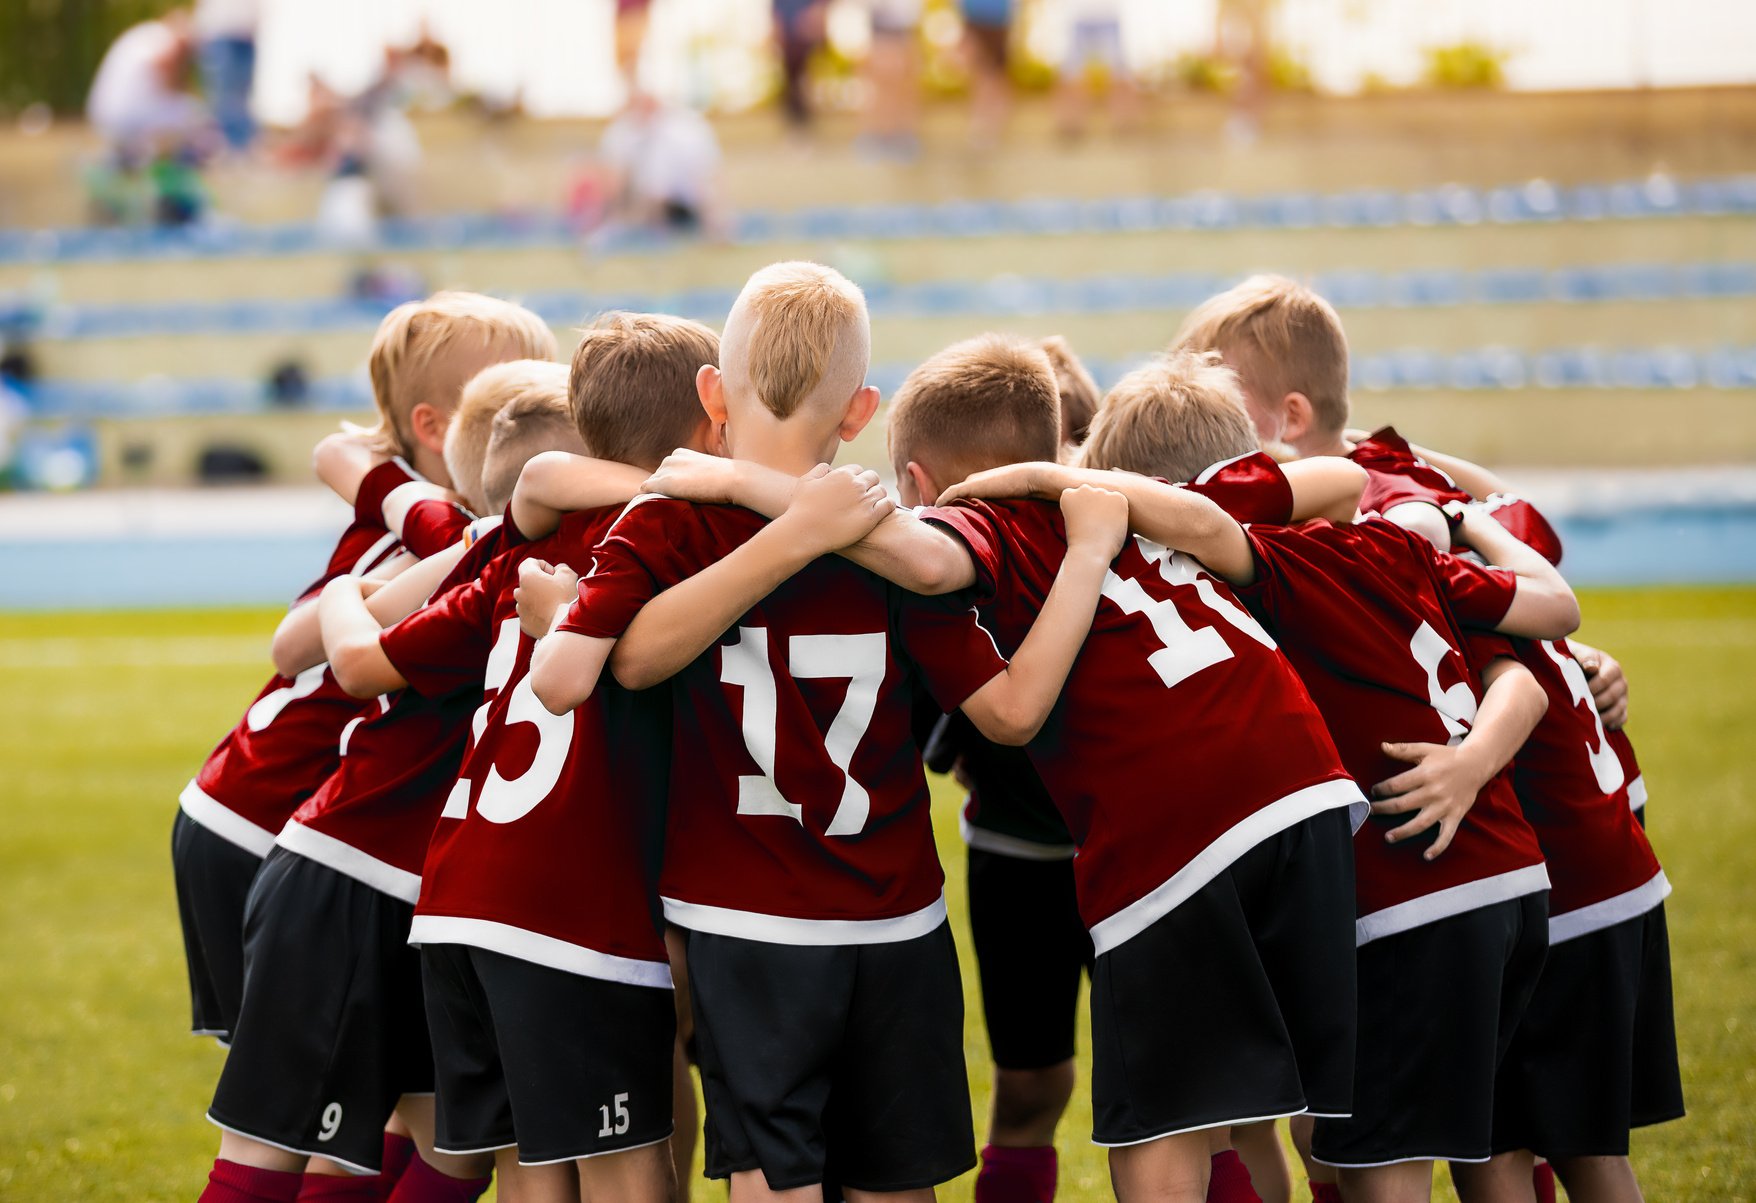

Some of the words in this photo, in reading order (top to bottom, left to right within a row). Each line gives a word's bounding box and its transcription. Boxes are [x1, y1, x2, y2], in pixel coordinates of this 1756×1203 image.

[720, 626, 887, 836] 17
[317, 1101, 343, 1142] 9
[598, 1091, 630, 1138] 15
